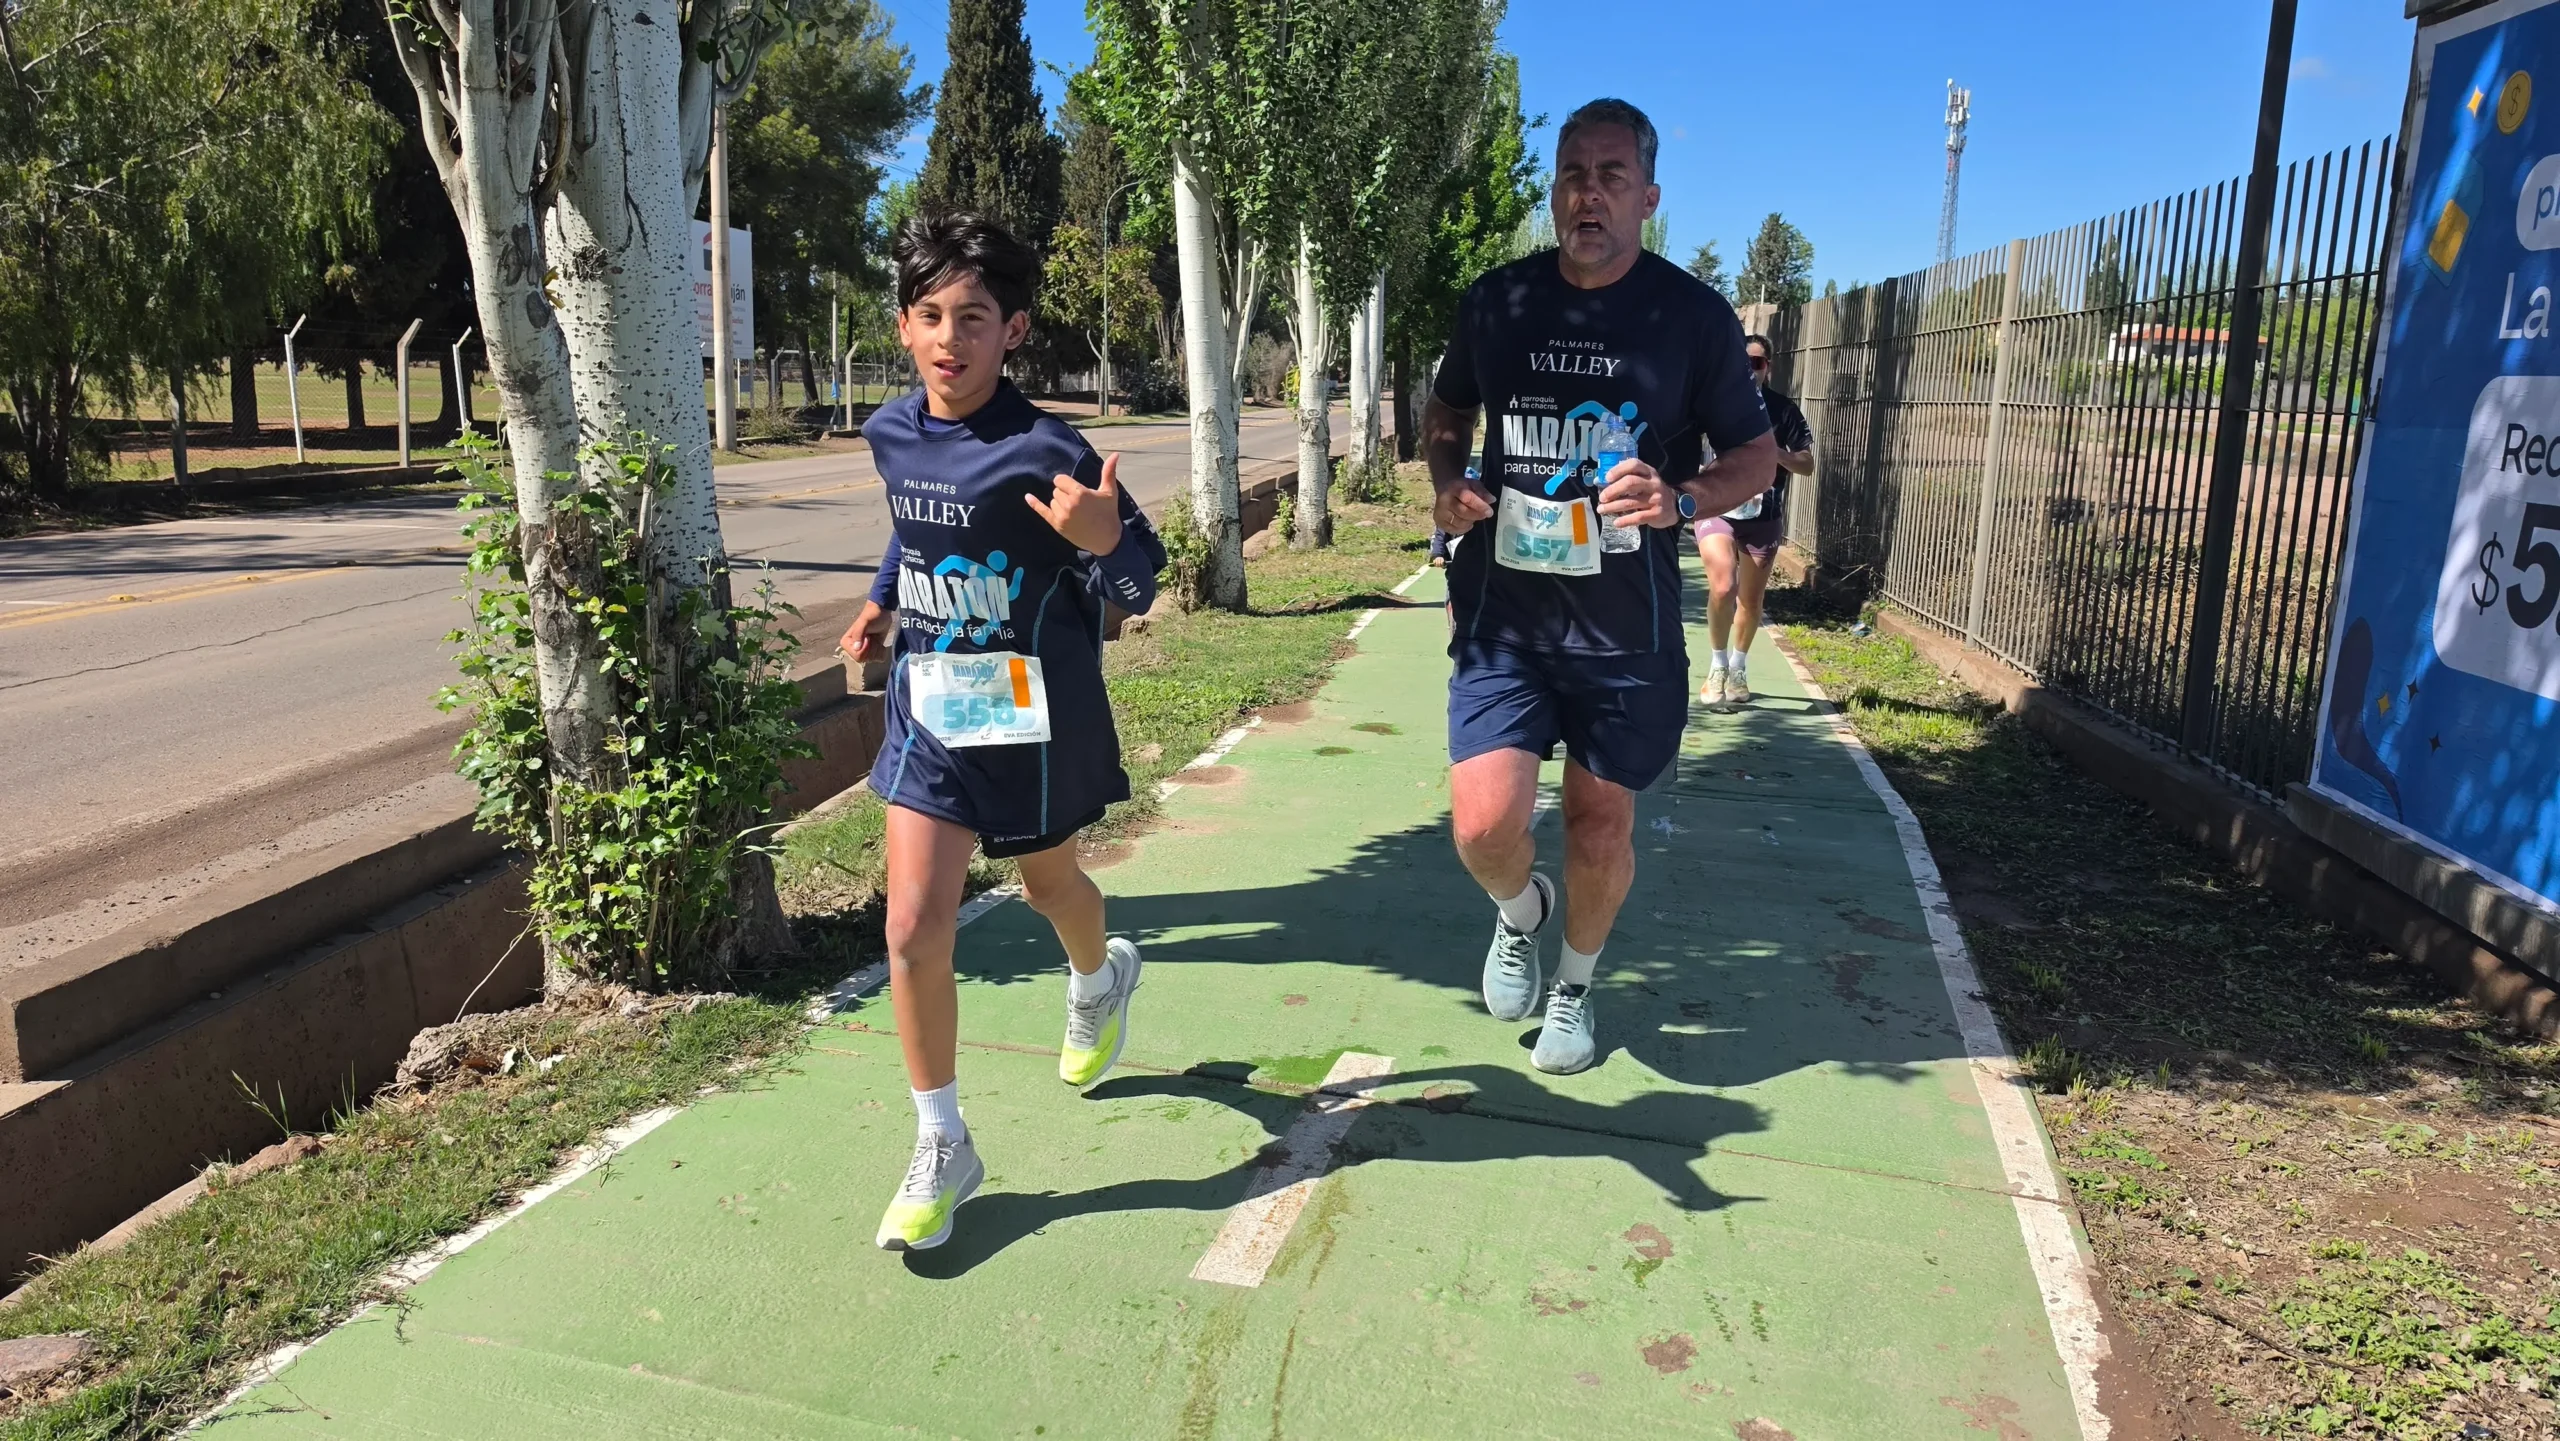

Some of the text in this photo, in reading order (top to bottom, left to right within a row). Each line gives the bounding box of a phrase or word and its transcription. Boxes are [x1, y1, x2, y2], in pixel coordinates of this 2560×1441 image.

[2499, 272, 2551, 340] La
[1548, 339, 1605, 351] PALMARES
[1529, 352, 1621, 378] VALLEY
[1502, 411, 1632, 462] MARATÓ
[1504, 462, 1530, 475] para
[1533, 461, 1562, 475] toda
[1566, 463, 1577, 477] la
[903, 479, 957, 495] PALMARES
[891, 494, 976, 528] VALLEY
[1515, 532, 1572, 562] 557
[901, 616, 923, 629] ara
[951, 623, 965, 638] la
[942, 697, 1017, 729] 558
